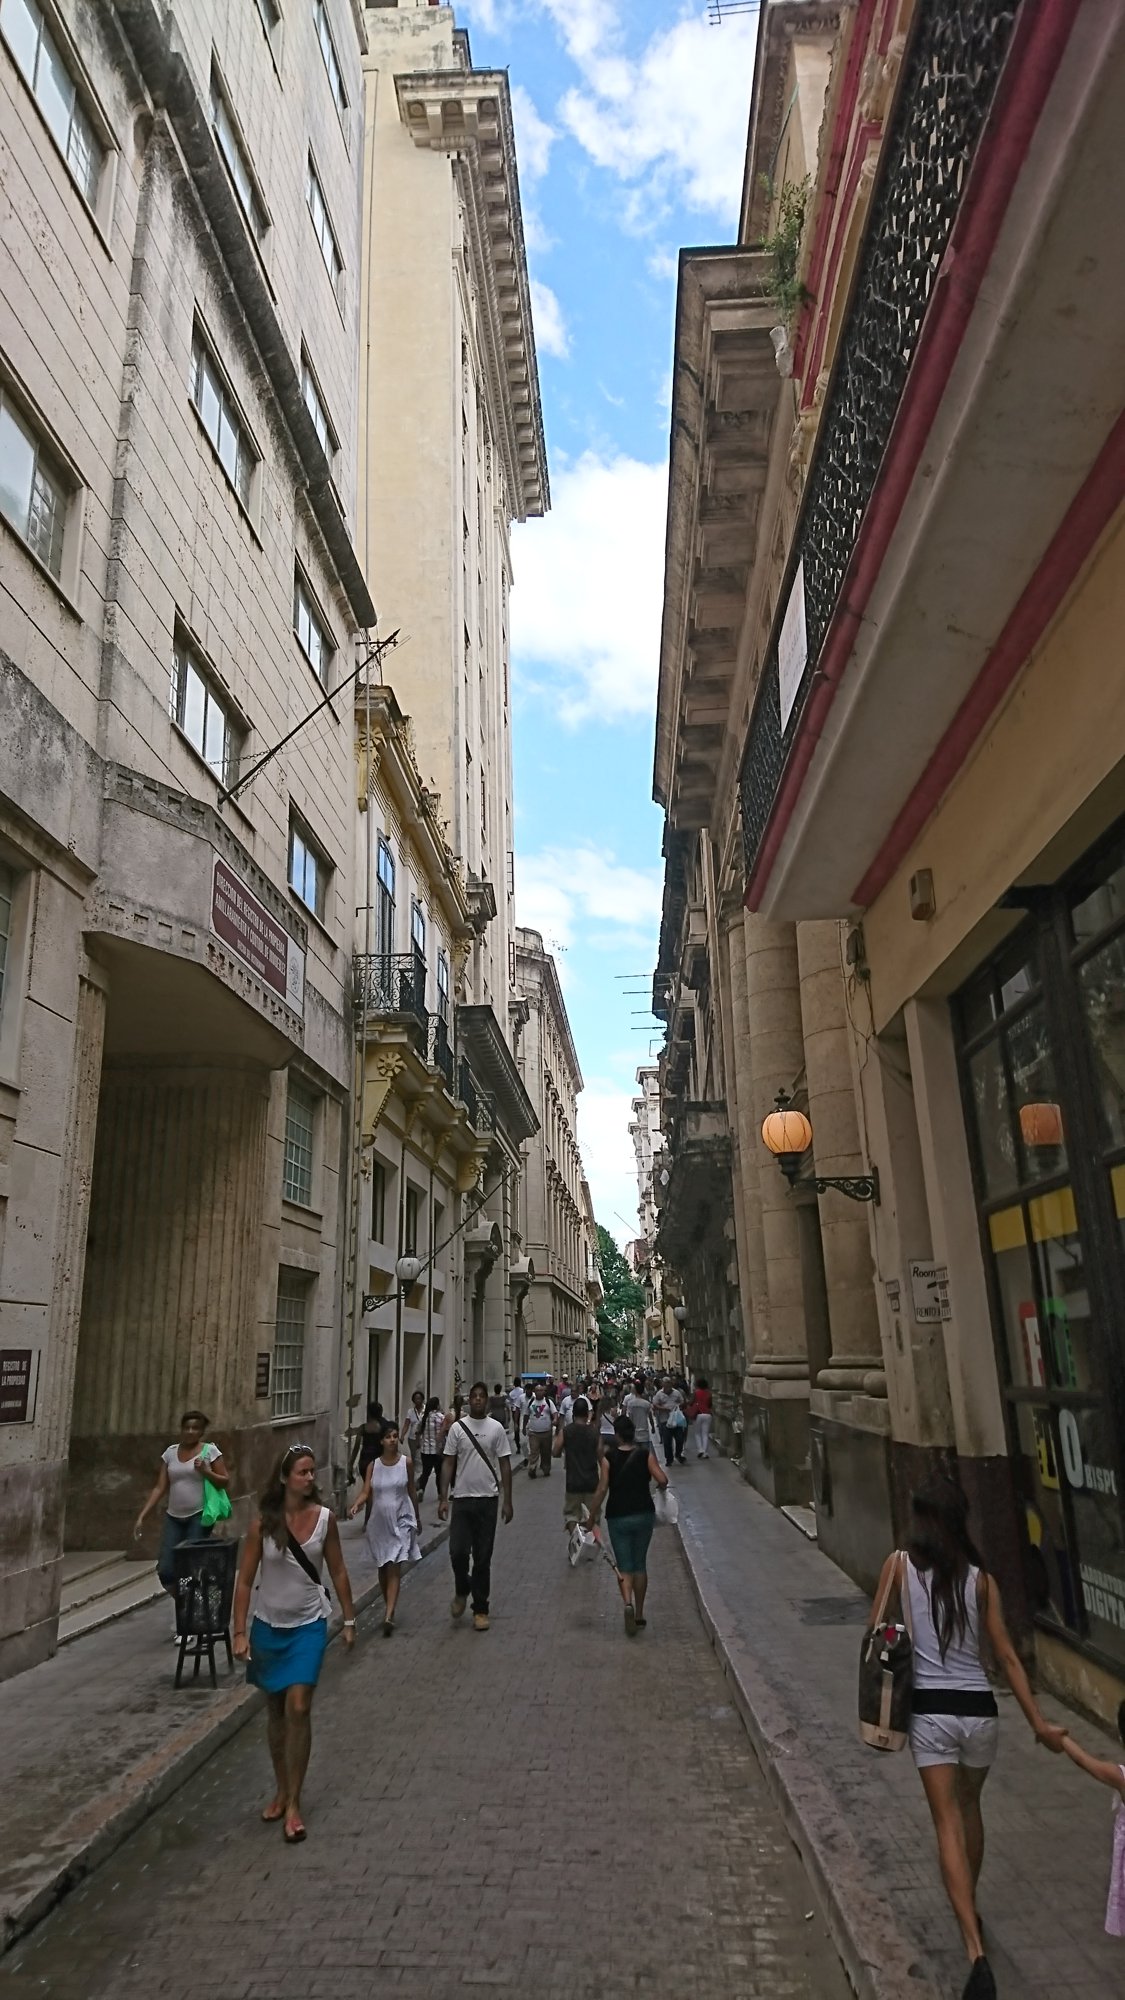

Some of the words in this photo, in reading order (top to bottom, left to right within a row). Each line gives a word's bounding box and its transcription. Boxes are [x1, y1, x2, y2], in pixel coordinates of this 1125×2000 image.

[244, 901, 259, 929] REGISTRO
[250, 928, 264, 956] CONTROL
[912, 1266, 936, 1278] Room
